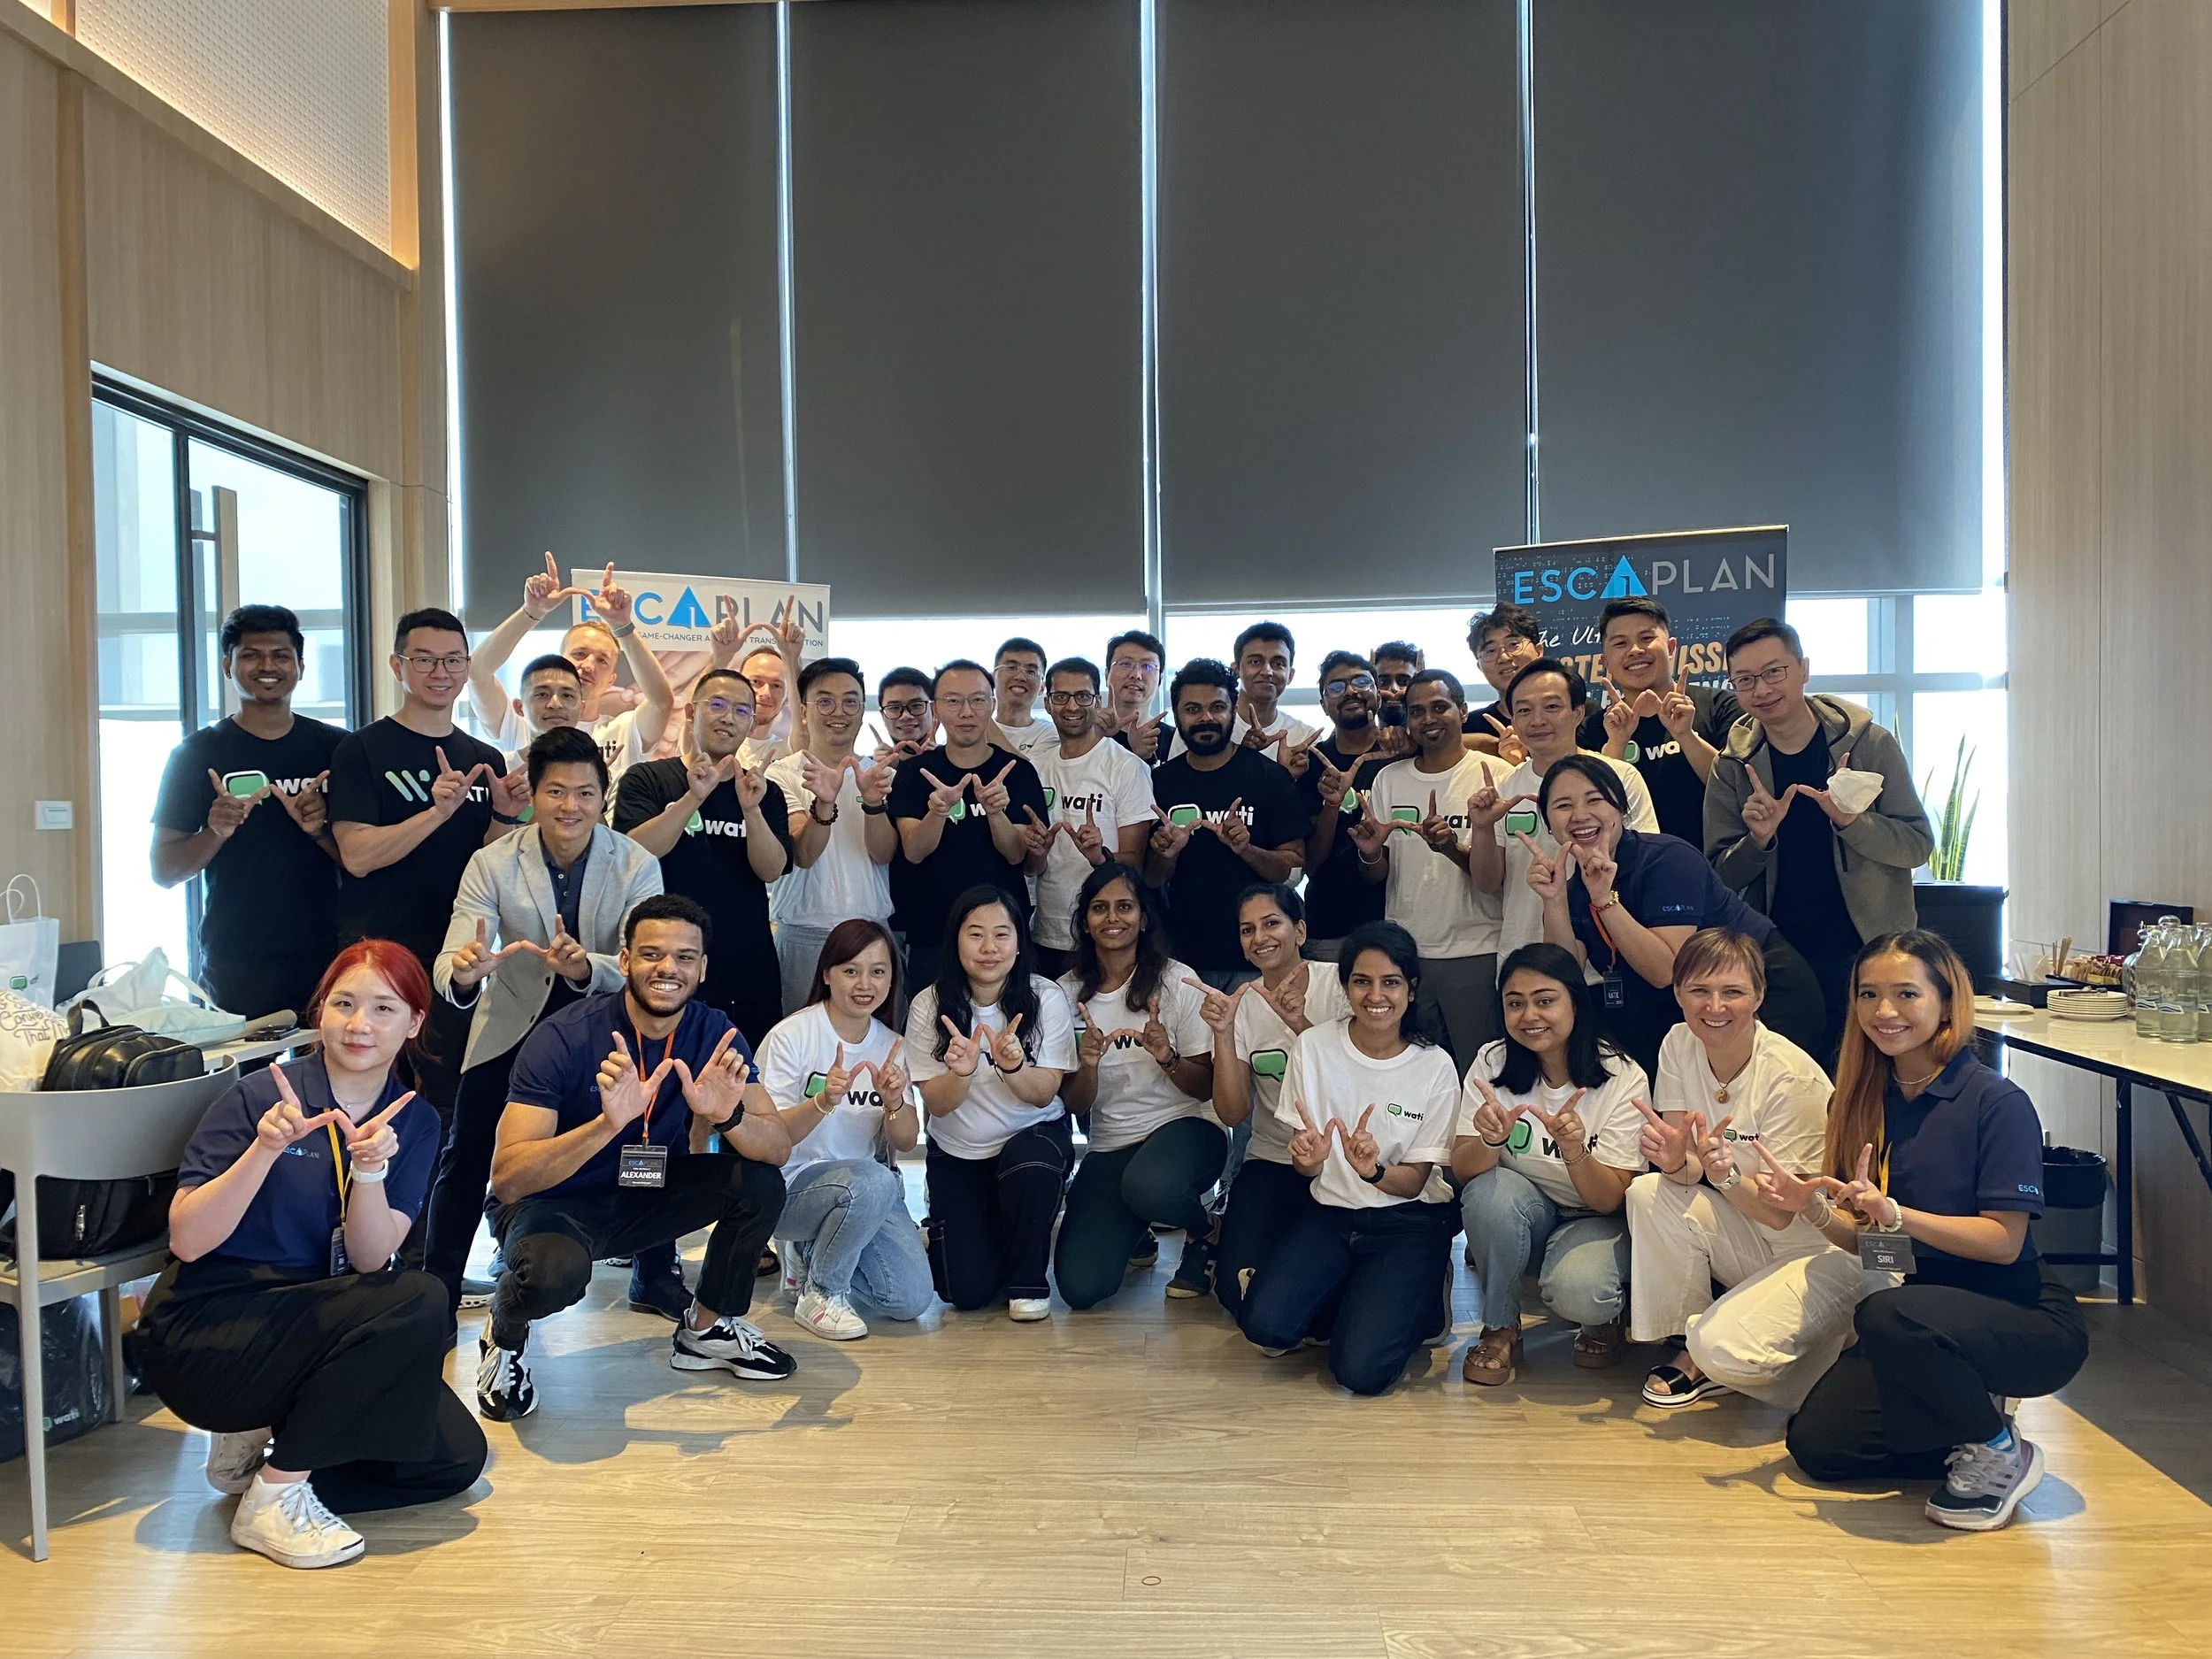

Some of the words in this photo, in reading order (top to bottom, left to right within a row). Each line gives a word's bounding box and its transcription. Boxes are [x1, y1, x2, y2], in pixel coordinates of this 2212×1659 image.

[1514, 554, 1776, 605] ESCAPLAN
[580, 585, 824, 634] ECAPLAN
[1645, 741, 1681, 761] wa
[704, 819, 747, 838] wat
[848, 1090, 883, 1107] wa
[1403, 1110, 1425, 1122] wati
[620, 1171, 662, 1179] ALEXANDER
[1877, 1255, 1894, 1264] SIRI
